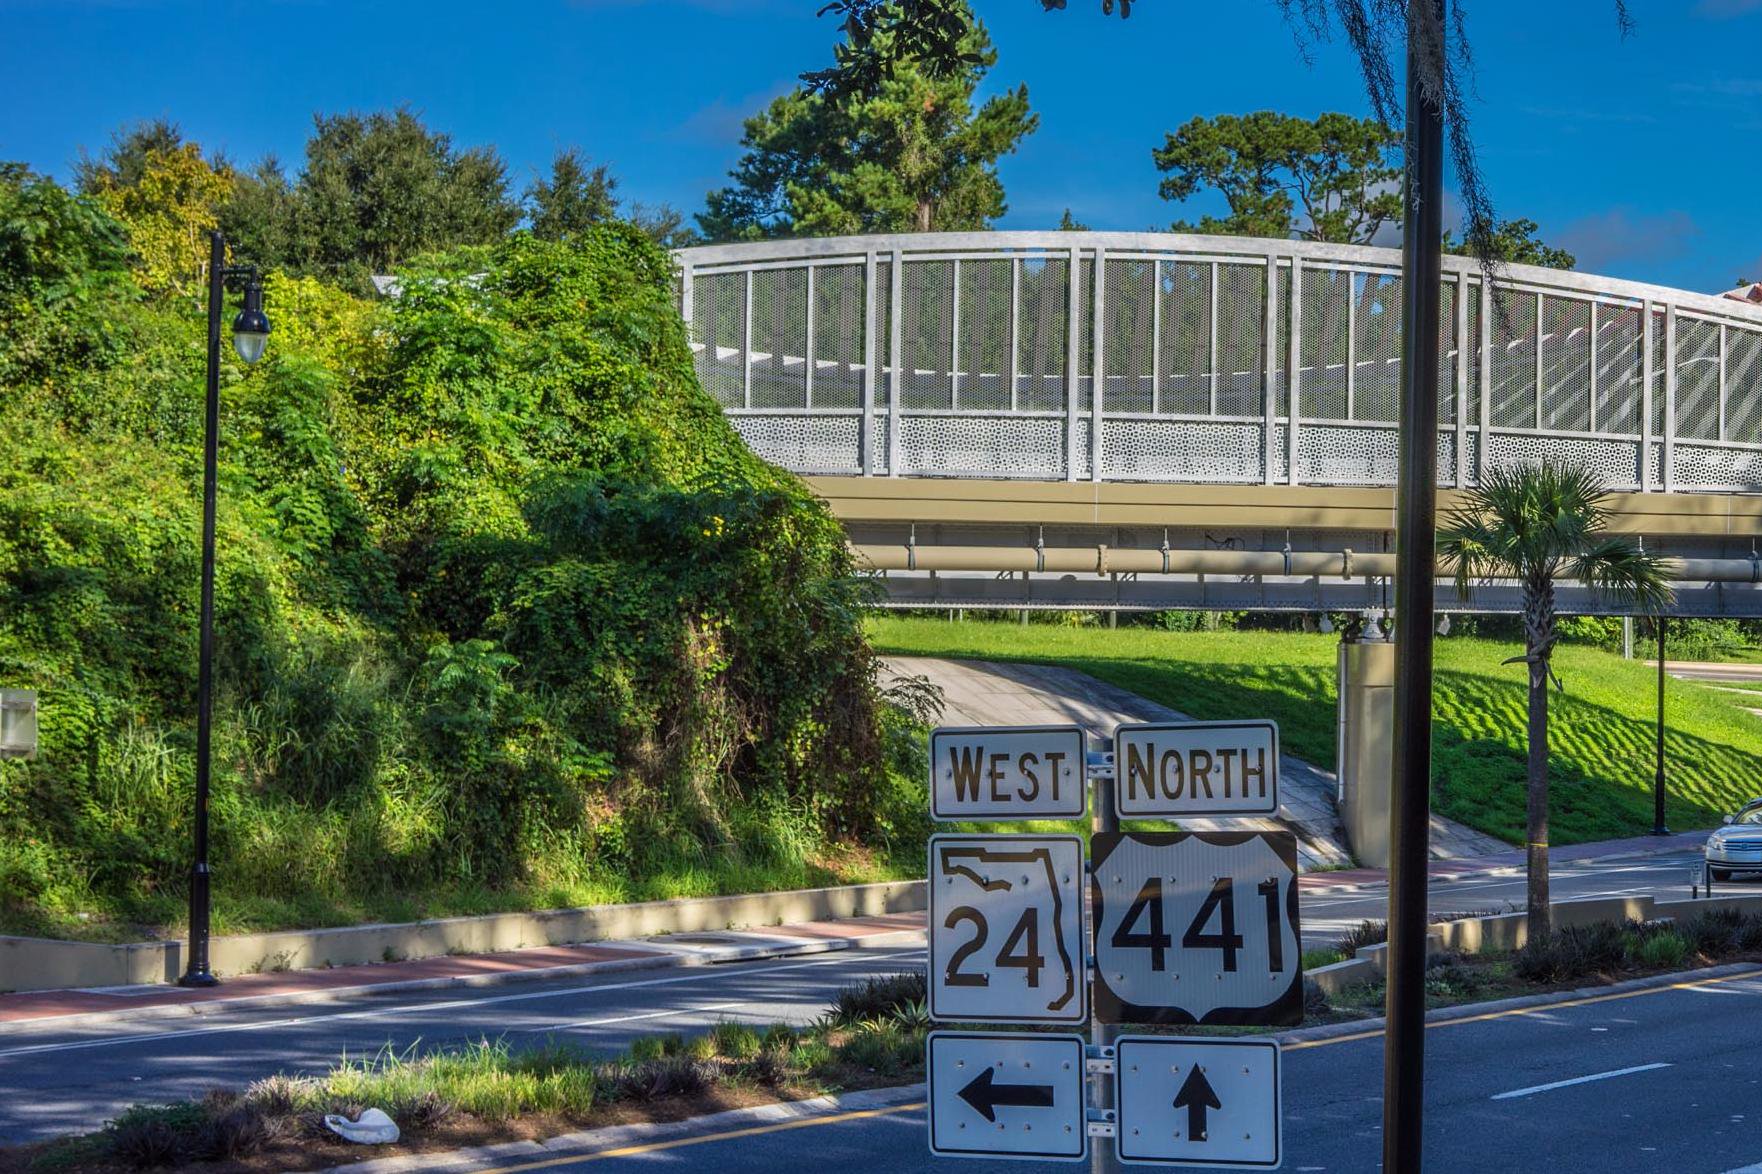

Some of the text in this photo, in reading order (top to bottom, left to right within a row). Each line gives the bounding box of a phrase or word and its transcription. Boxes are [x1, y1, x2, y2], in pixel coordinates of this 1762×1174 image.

[949, 746, 1066, 802] WEST
[1127, 743, 1266, 800] NORTH
[944, 905, 1045, 988] 24
[1111, 876, 1284, 973] 441
